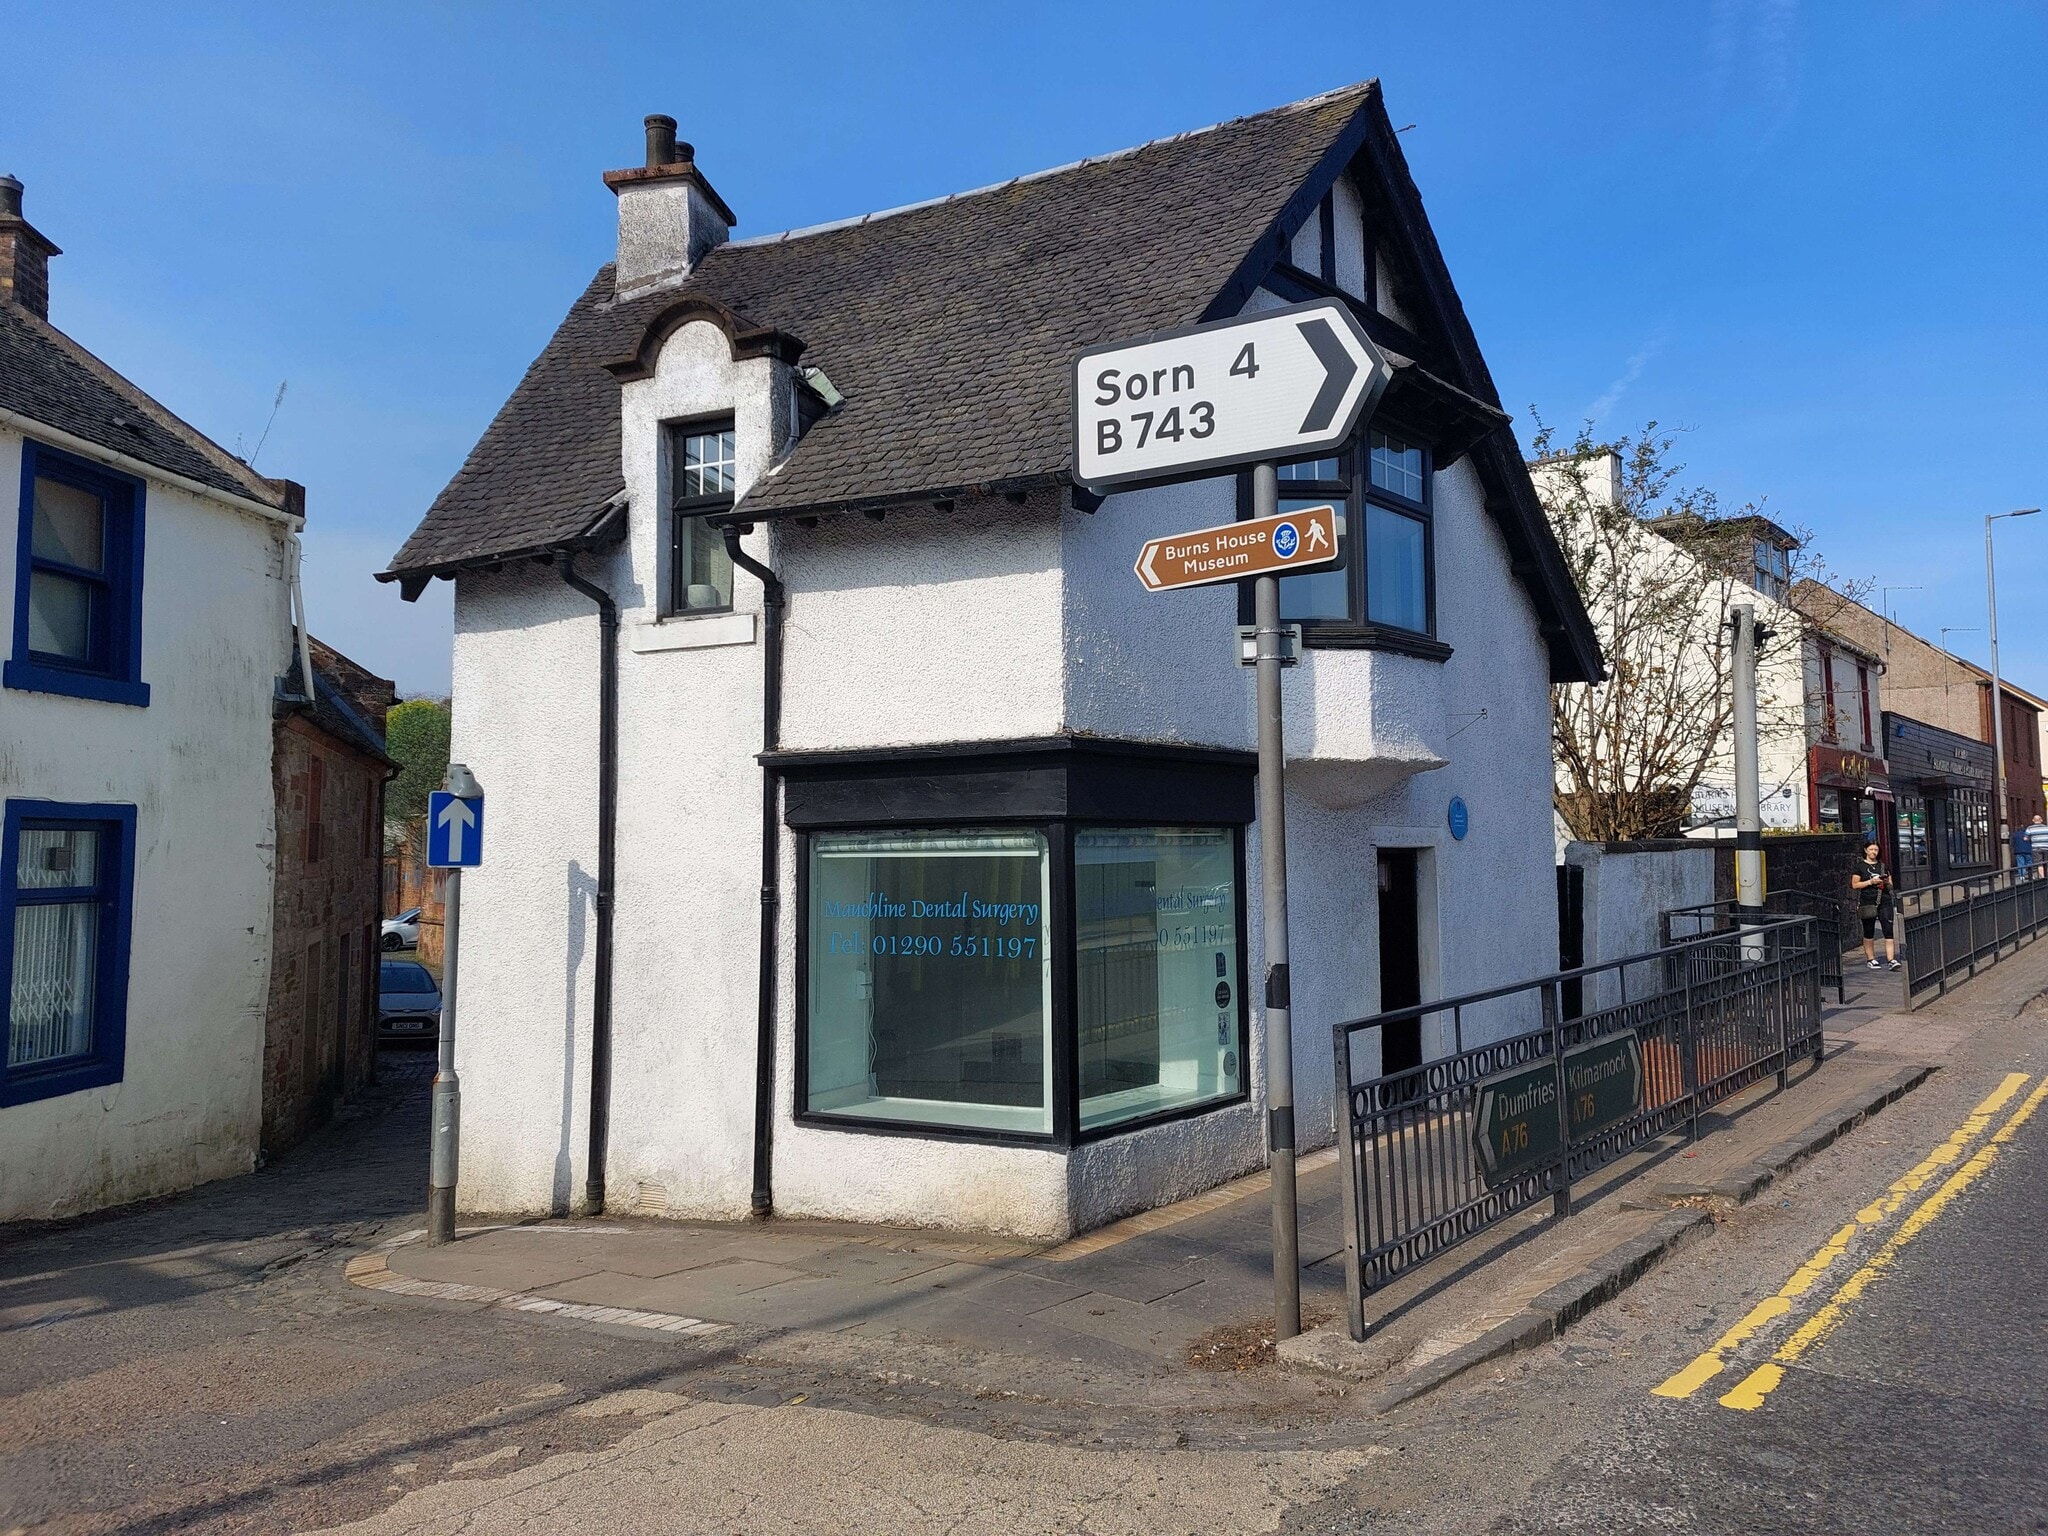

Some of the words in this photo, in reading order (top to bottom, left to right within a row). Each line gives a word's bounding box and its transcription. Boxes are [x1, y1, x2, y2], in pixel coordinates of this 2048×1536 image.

[1095, 363, 1195, 406] Sorn
[1229, 342, 1260, 379] 4
[1165, 542, 1210, 561] Burns
[1216, 531, 1267, 551] House
[1184, 552, 1249, 574] Museum
[824, 891, 907, 921] Mauchline
[911, 891, 968, 918] Dental
[972, 900, 1039, 926] Surgery
[1157, 885, 1184, 911] ental
[829, 931, 866, 956] Tel:
[872, 935, 943, 956] 01290
[949, 935, 1037, 959] 551197
[1173, 925, 1225, 946] 551197
[1568, 1049, 1628, 1092] Kilmarnock
[1498, 1080, 1555, 1121] Dumfries
